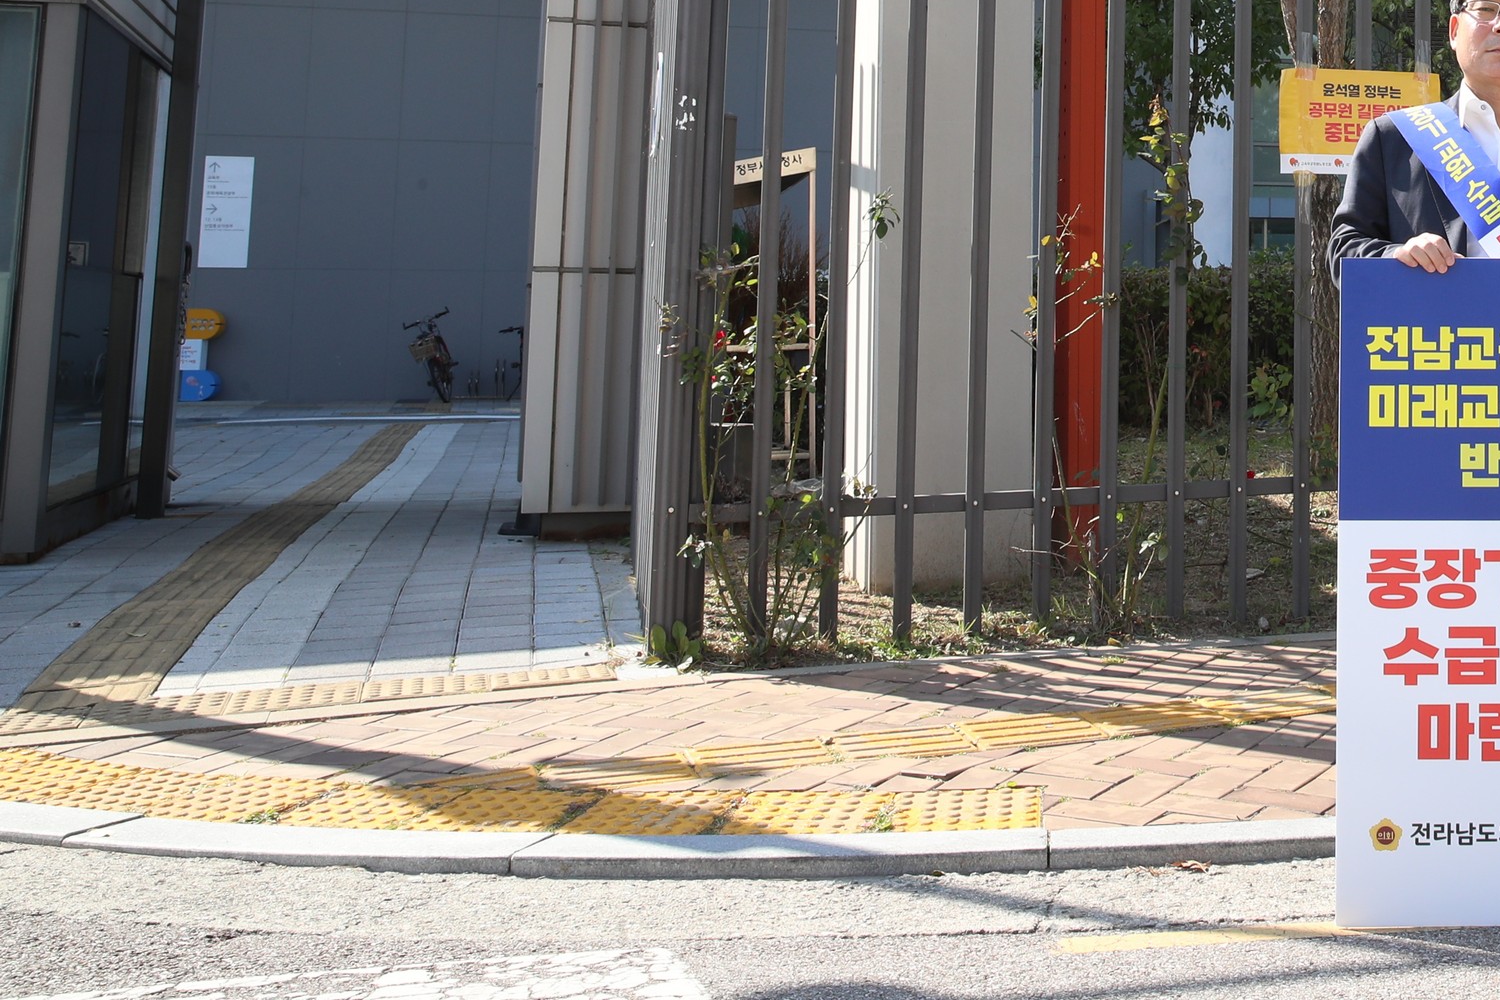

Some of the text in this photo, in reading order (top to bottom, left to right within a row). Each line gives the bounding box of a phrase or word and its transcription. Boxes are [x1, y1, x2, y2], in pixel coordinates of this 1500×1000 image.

[1323, 83, 1401, 99] 윤석열 정부는
[1309, 102, 1352, 118] 공무원
[1324, 122, 1363, 143] 중단
[736, 154, 802, 176] 정부청사
[1433, 137, 1475, 182] 교원
[1383, 626, 1500, 686] 수급
[1377, 831, 1394, 841] 의회
